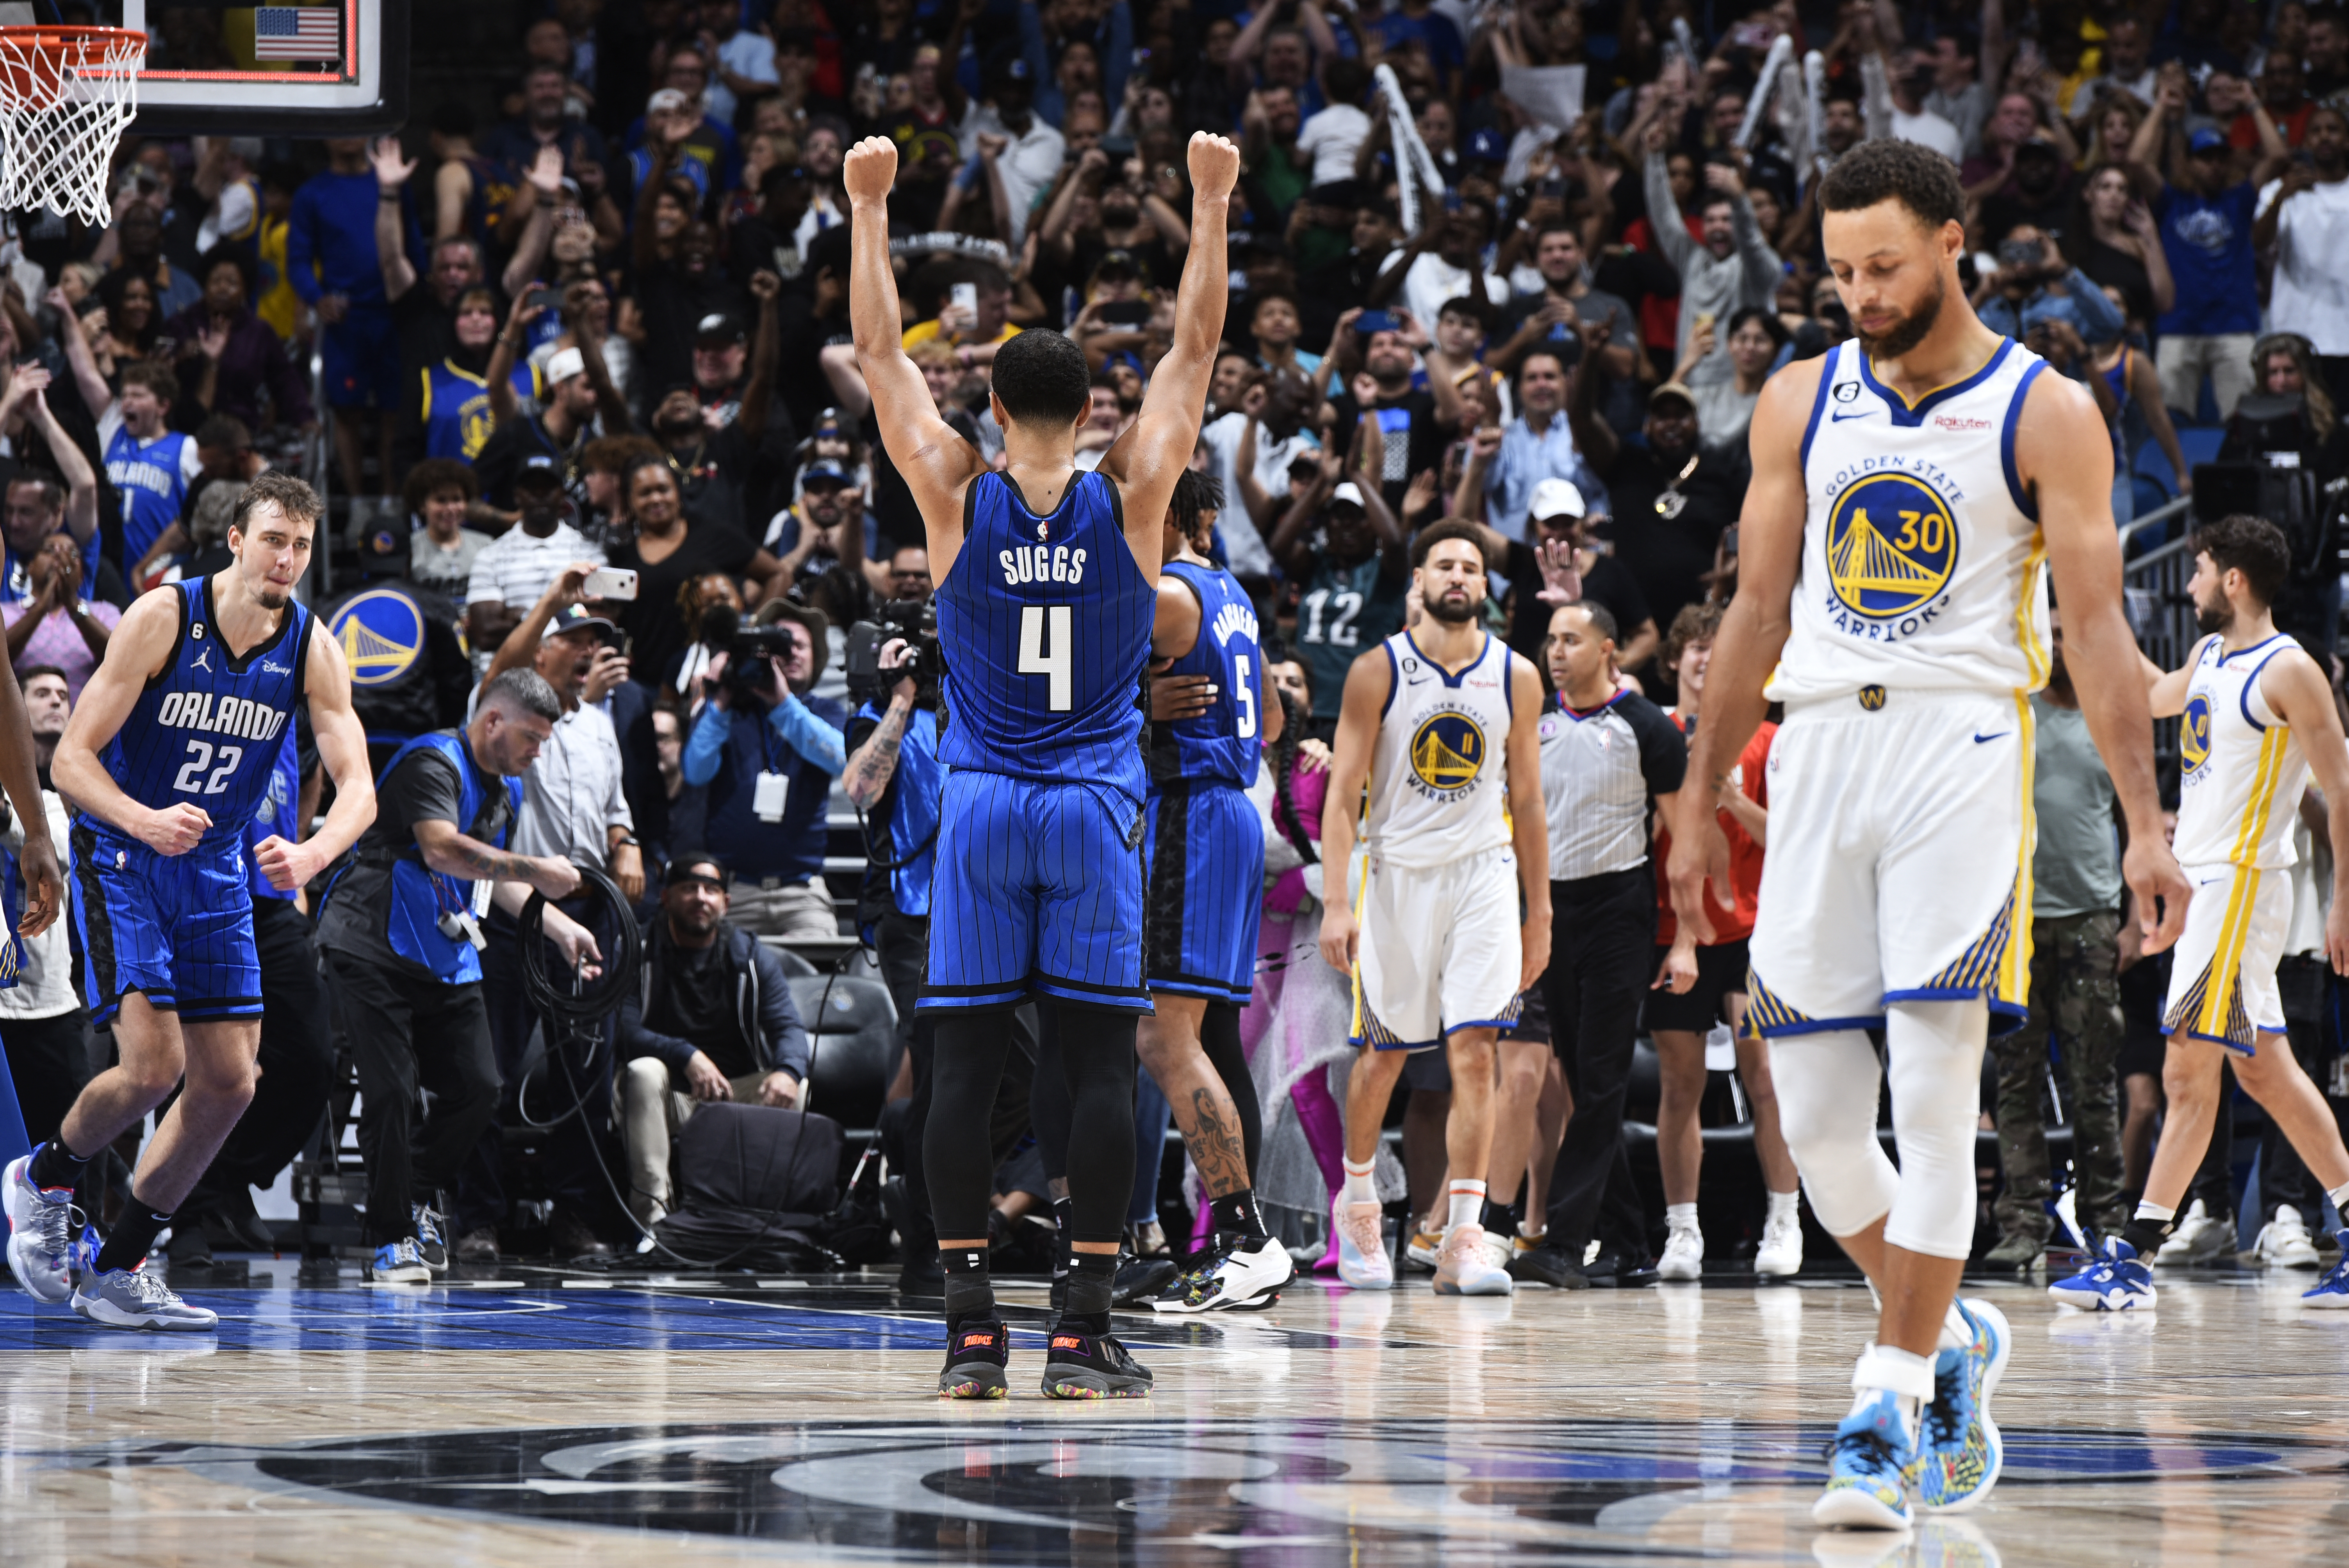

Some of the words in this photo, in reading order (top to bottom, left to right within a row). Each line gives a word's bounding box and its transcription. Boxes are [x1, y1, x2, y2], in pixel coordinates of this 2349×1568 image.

[1837, 383, 1857, 401] 6
[1936, 415, 1992, 430] Rakuten
[1826, 456, 1905, 496] GOLDEN
[1914, 459, 1965, 505] STATE
[1894, 510, 1945, 554] 30
[999, 545, 1087, 585] SUGGS
[192, 623, 203, 639] 6
[1303, 588, 1363, 647] 12
[1018, 606, 1071, 711] 4
[1235, 647, 1256, 738] 5
[1859, 688, 1884, 709] W
[158, 691, 286, 741] ORLANDO
[1412, 702, 1454, 725] GOLDEN
[1461, 703, 1489, 727] STATE
[1461, 732, 1474, 755] 11
[173, 739, 242, 795] 22
[1406, 772, 1482, 803] WARRIORS
[964, 1335, 993, 1347] DAME
